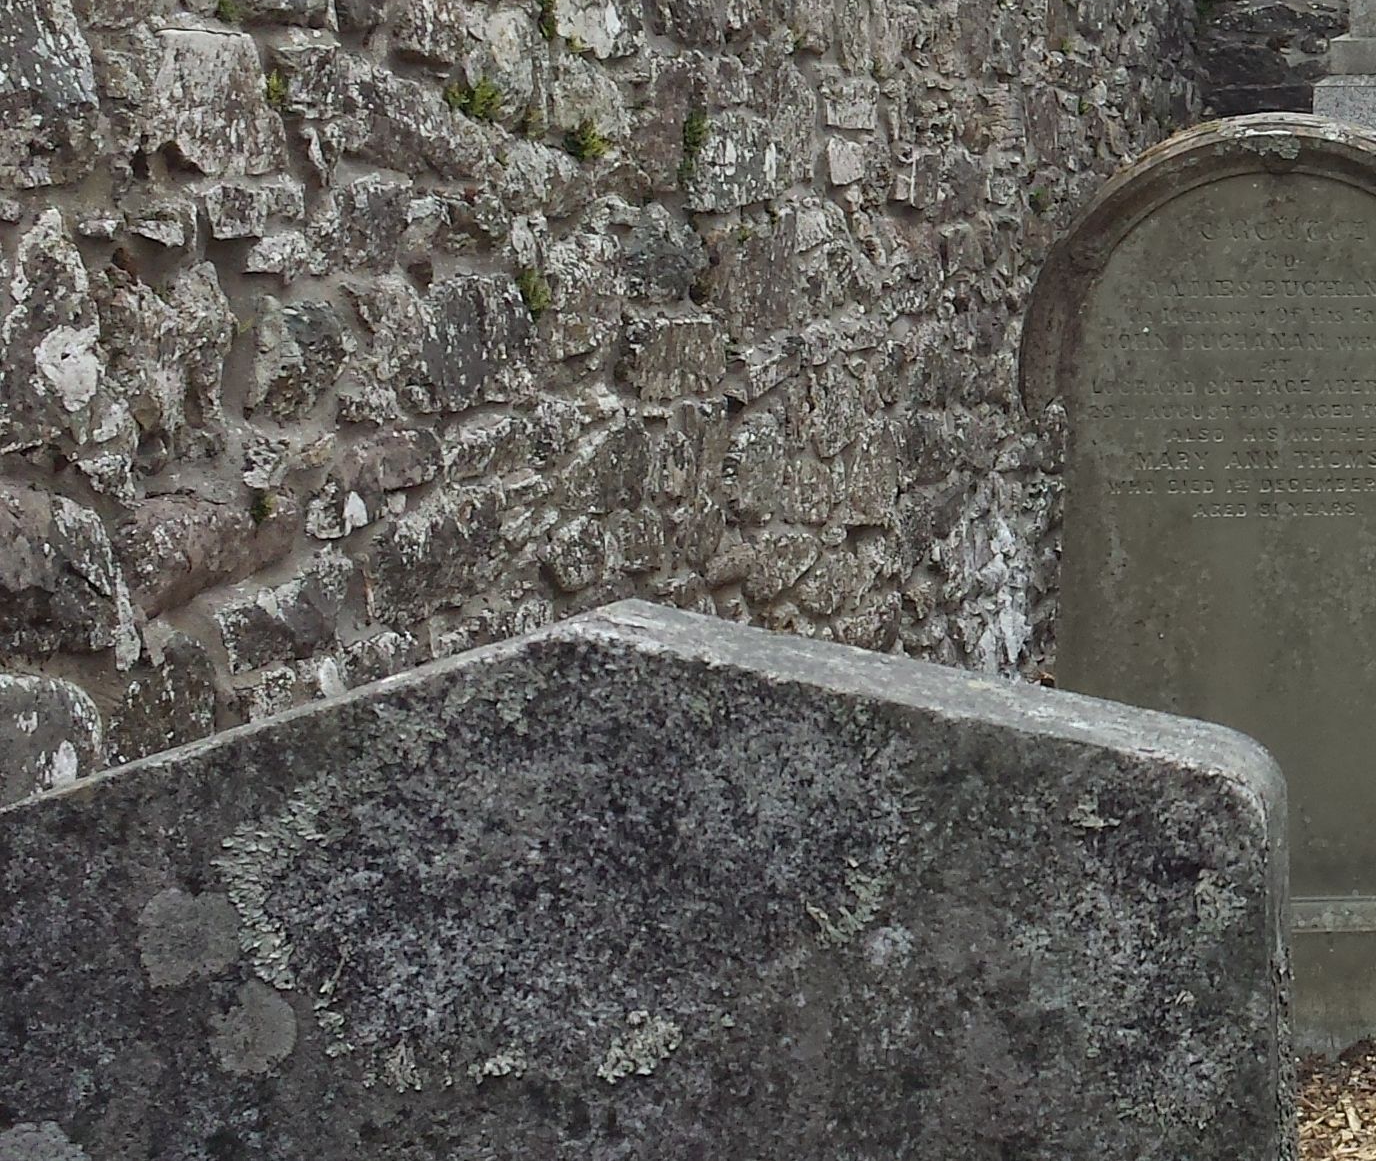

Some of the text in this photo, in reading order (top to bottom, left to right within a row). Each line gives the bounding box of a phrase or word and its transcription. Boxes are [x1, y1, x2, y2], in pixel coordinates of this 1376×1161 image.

[1148, 280, 1250, 298] JAMES
[1161, 307, 1266, 327] Memory
[1309, 307, 1344, 324] His
[1100, 333, 1169, 351] JOHN
[1091, 377, 1196, 396] LOCHARD
[1205, 378, 1312, 395] COTTAGE
[1143, 404, 1233, 420] AUGUST
[1240, 404, 1296, 420] 1904
[1303, 403, 1354, 419] AGED
[1165, 428, 1226, 443] ALSO
[1242, 427, 1279, 443] HIS
[1134, 450, 1209, 471] MARY
[1224, 450, 1281, 470] ANN
[1107, 479, 1155, 495] WHO
[1166, 478, 1216, 494] DIED
[1193, 502, 1249, 518] AGED
